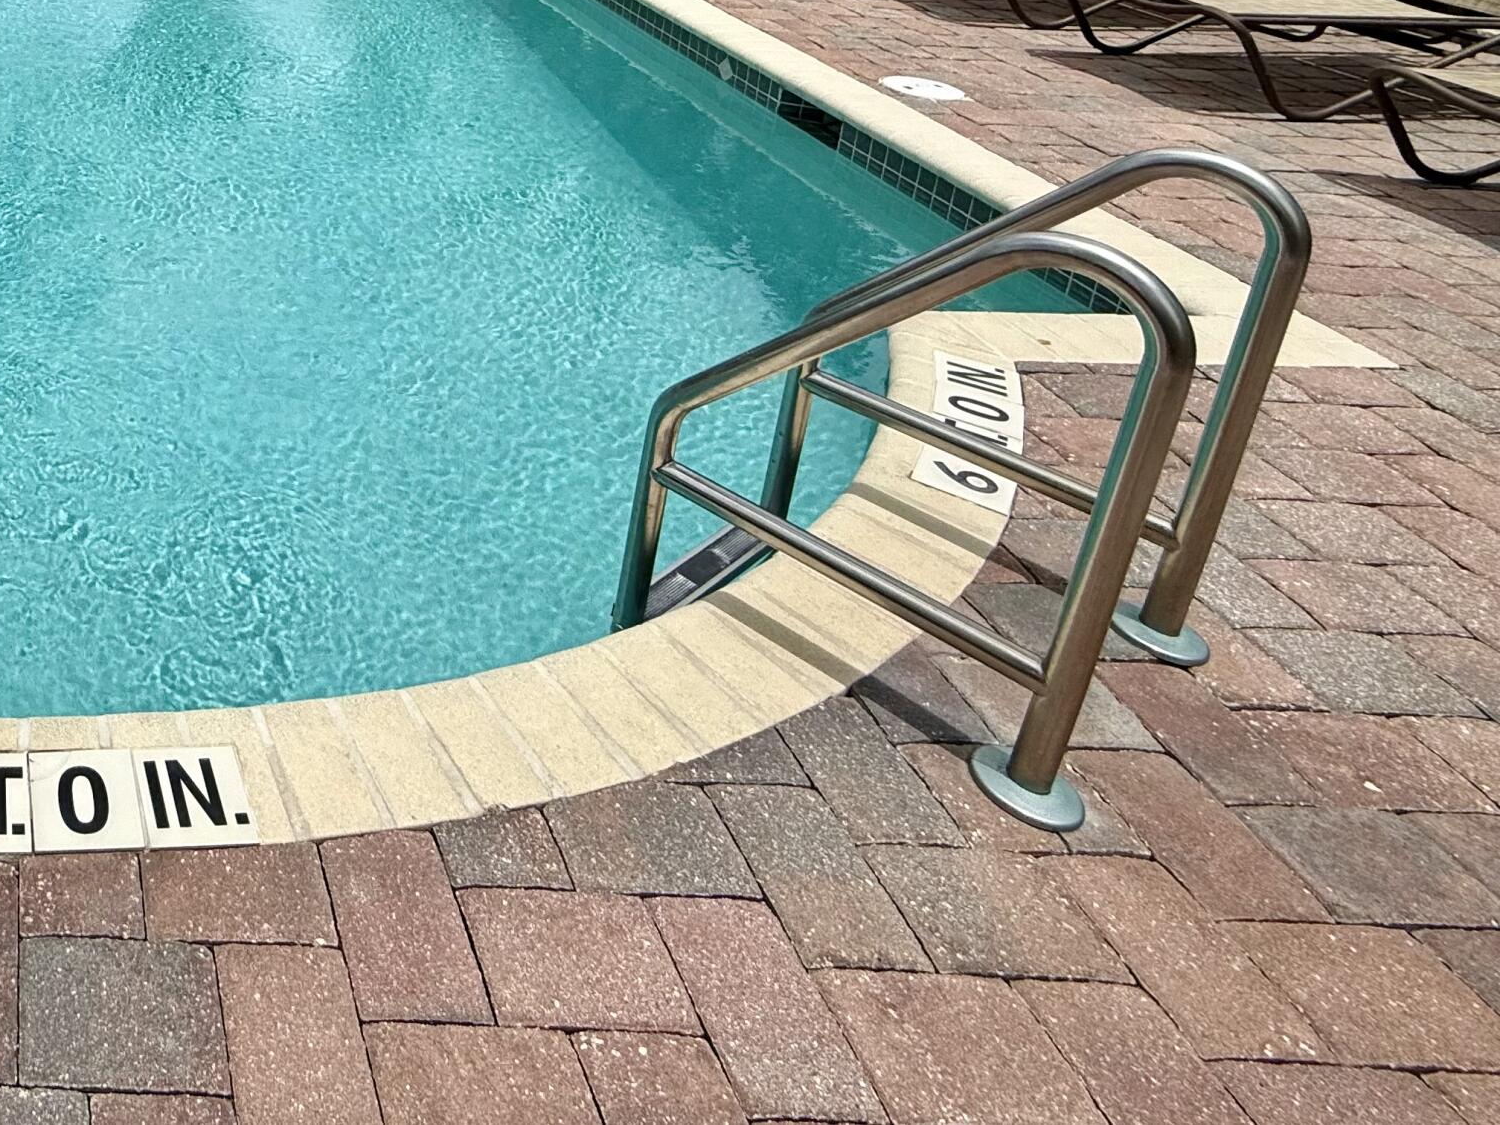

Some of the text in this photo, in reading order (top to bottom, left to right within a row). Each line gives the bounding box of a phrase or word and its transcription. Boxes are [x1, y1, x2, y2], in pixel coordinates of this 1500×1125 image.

[946, 360, 1009, 397] IN.
[948, 395, 1010, 422] 0
[932, 460, 999, 494] 6
[57, 765, 110, 835] 0
[143, 757, 251, 830] IN.
